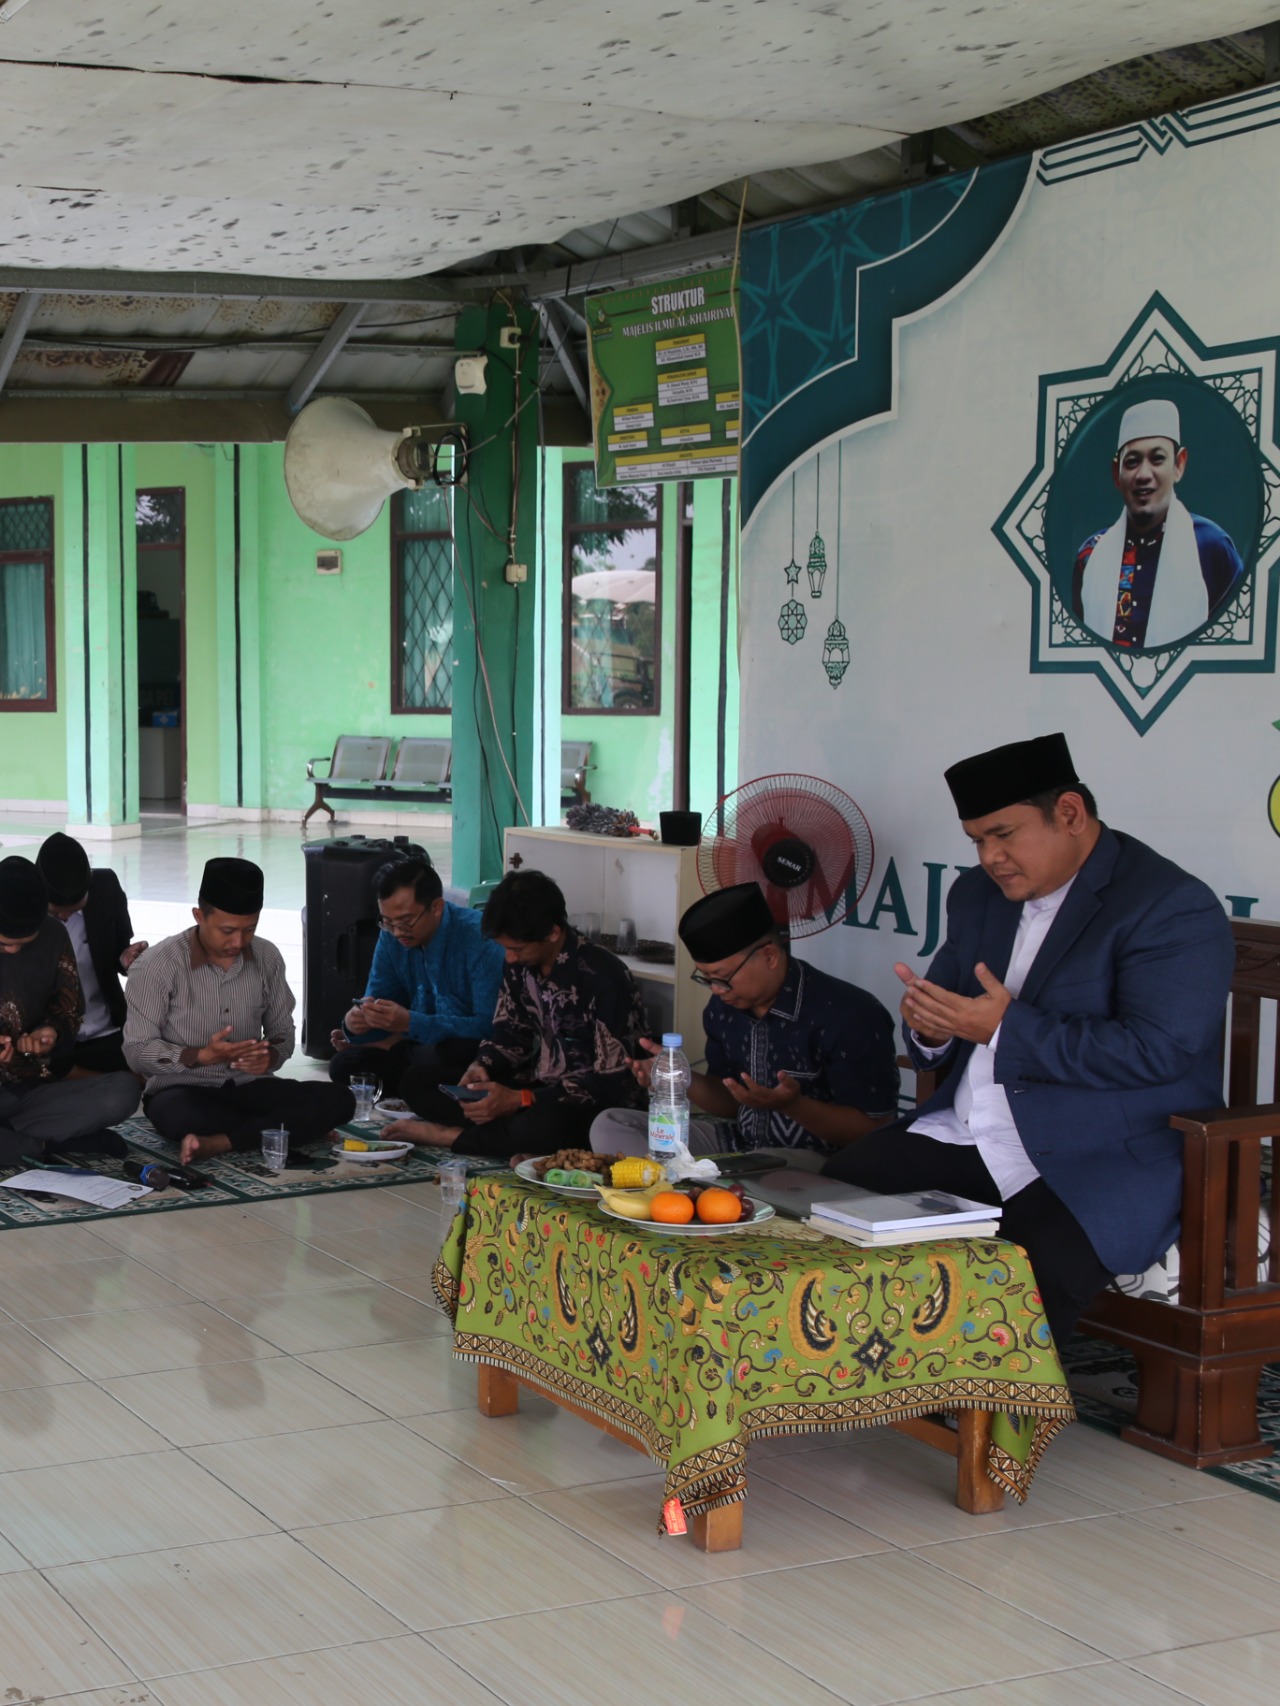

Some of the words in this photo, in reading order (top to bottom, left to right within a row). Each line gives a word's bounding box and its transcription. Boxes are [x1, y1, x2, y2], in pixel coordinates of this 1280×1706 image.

[651, 286, 705, 315] STRUKTUR
[623, 322, 654, 337] MAJELIS
[655, 317, 676, 332] ILMU
[776, 856, 802, 872] SEMAR
[656, 1126, 665, 1134] Le
